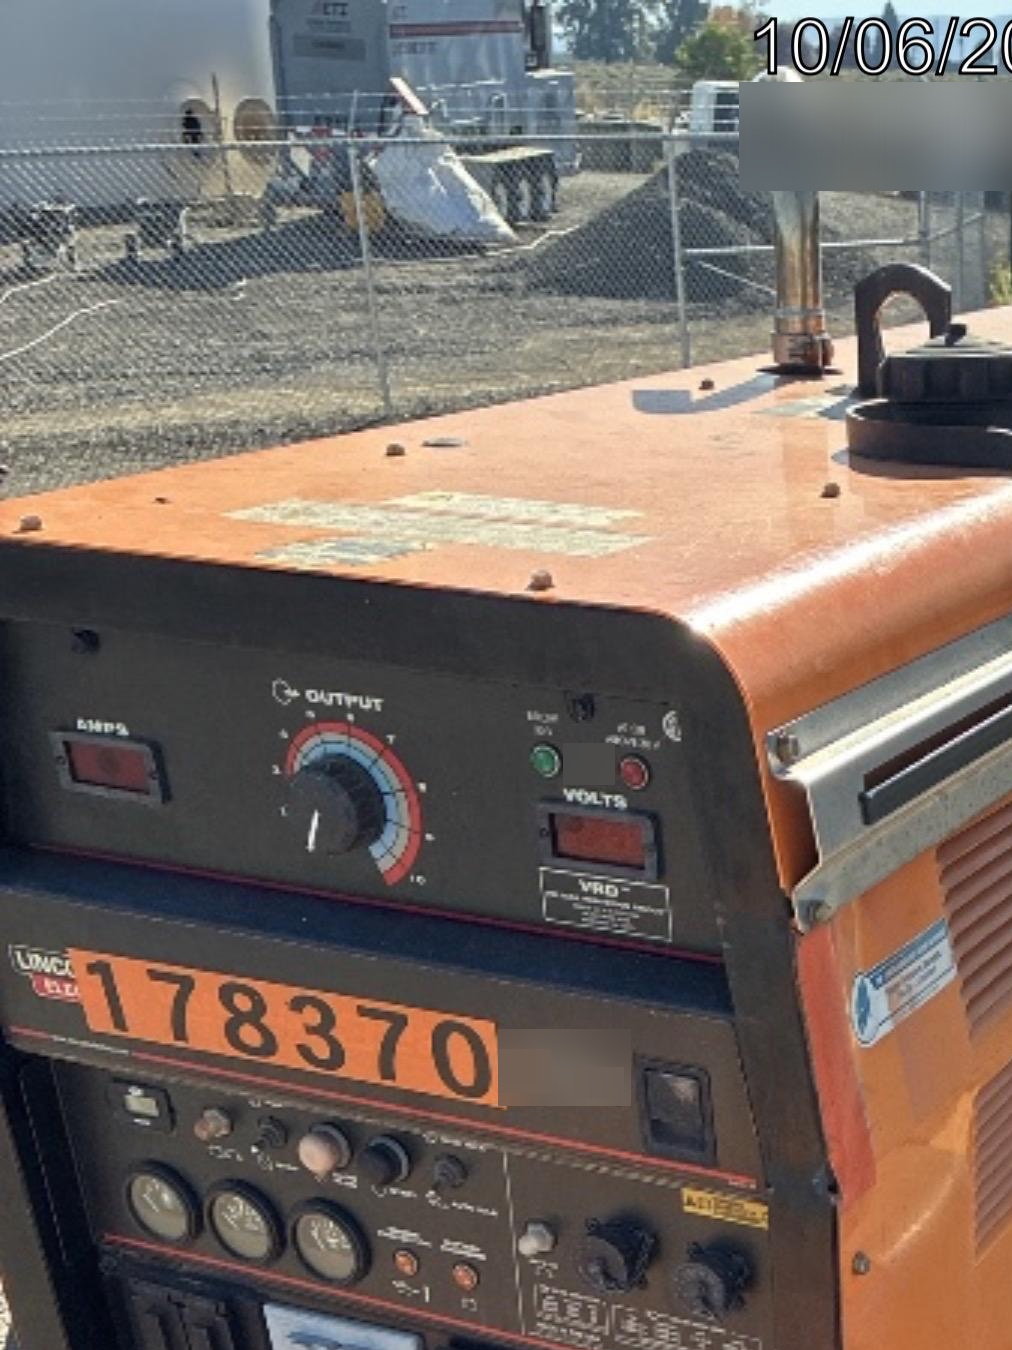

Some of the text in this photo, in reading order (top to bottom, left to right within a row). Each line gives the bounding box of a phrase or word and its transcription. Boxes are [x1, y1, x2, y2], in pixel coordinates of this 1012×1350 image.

[305, 689, 384, 711] OUTPUT
[562, 788, 629, 809] VOLTS
[86, 960, 493, 1099] 178370
